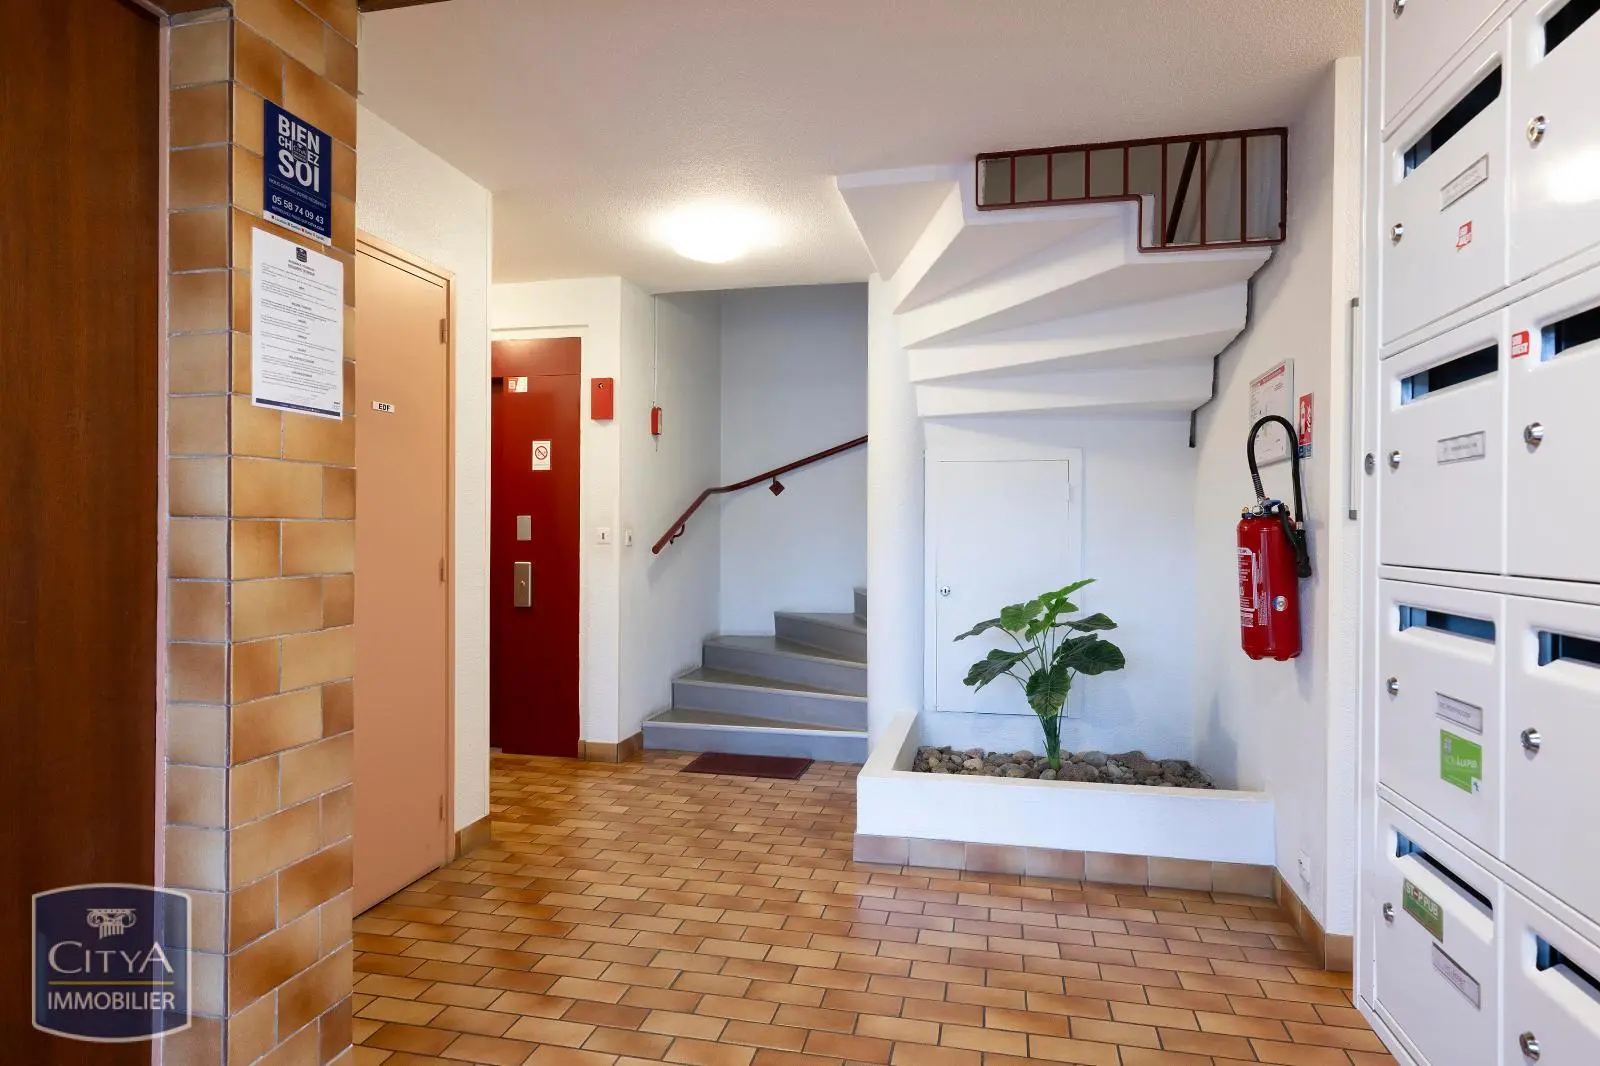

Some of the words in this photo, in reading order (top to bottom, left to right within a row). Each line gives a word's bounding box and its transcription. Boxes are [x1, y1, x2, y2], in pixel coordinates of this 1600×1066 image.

[278, 114, 320, 155] BIEN
[278, 149, 320, 193] SOI
[271, 194, 282, 206] 05
[283, 199, 293, 211] 58
[294, 204, 304, 215] 74
[304, 209, 314, 220] 09
[315, 215, 324, 225] 43
[378, 403, 391, 412] EDF
[1423, 896, 1440, 917] PUB
